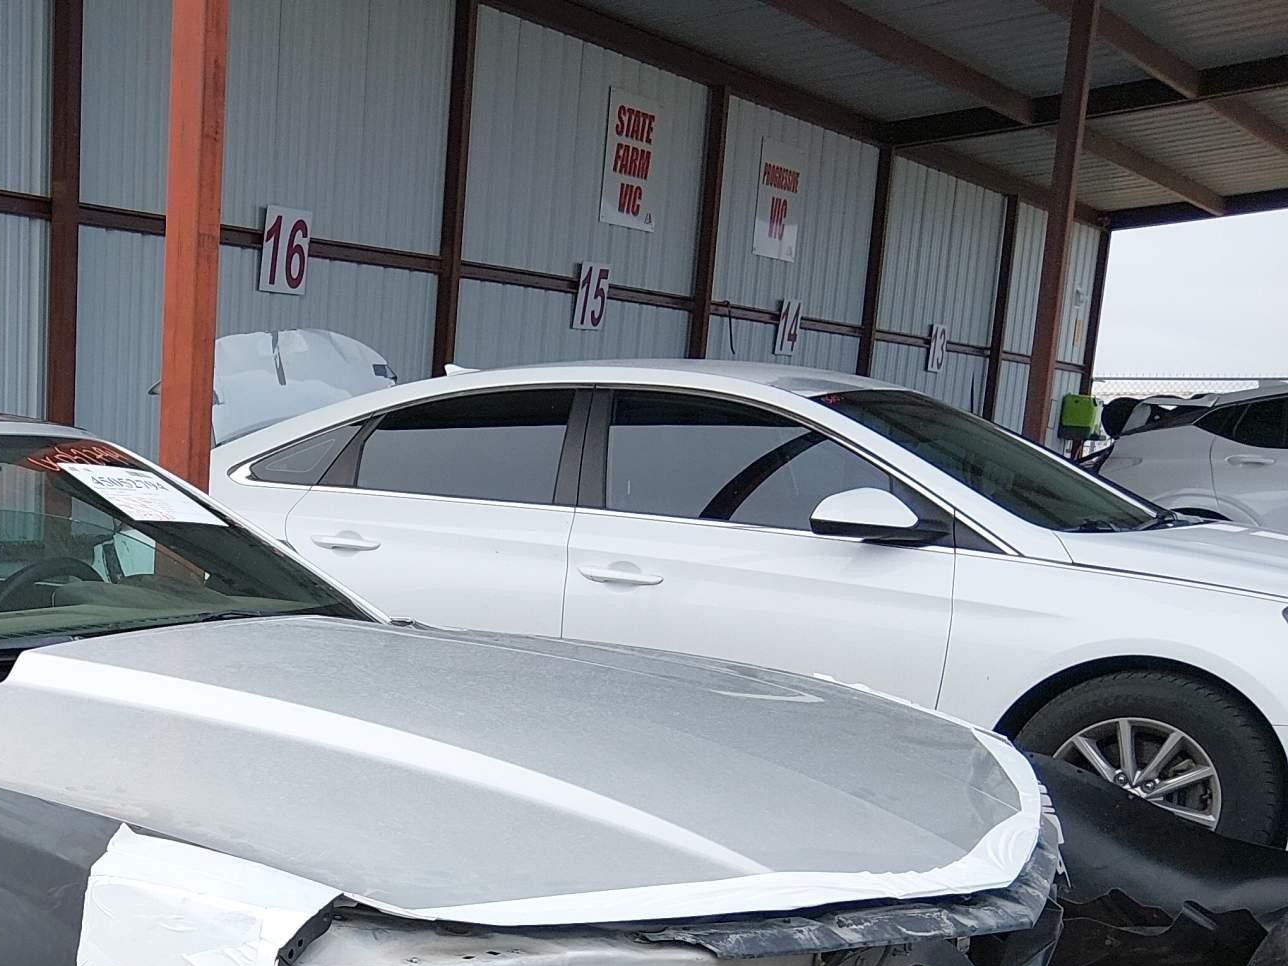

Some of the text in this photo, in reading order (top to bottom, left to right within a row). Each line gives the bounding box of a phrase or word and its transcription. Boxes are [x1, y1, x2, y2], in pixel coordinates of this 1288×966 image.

[615, 104, 656, 145] STATE
[612, 143, 652, 181] FARM
[618, 183, 643, 217] VIC
[768, 197, 788, 240] VIC
[265, 215, 308, 289] 16
[580, 266, 610, 327] 15
[779, 301, 801, 352] 14
[930, 326, 946, 370] 13
